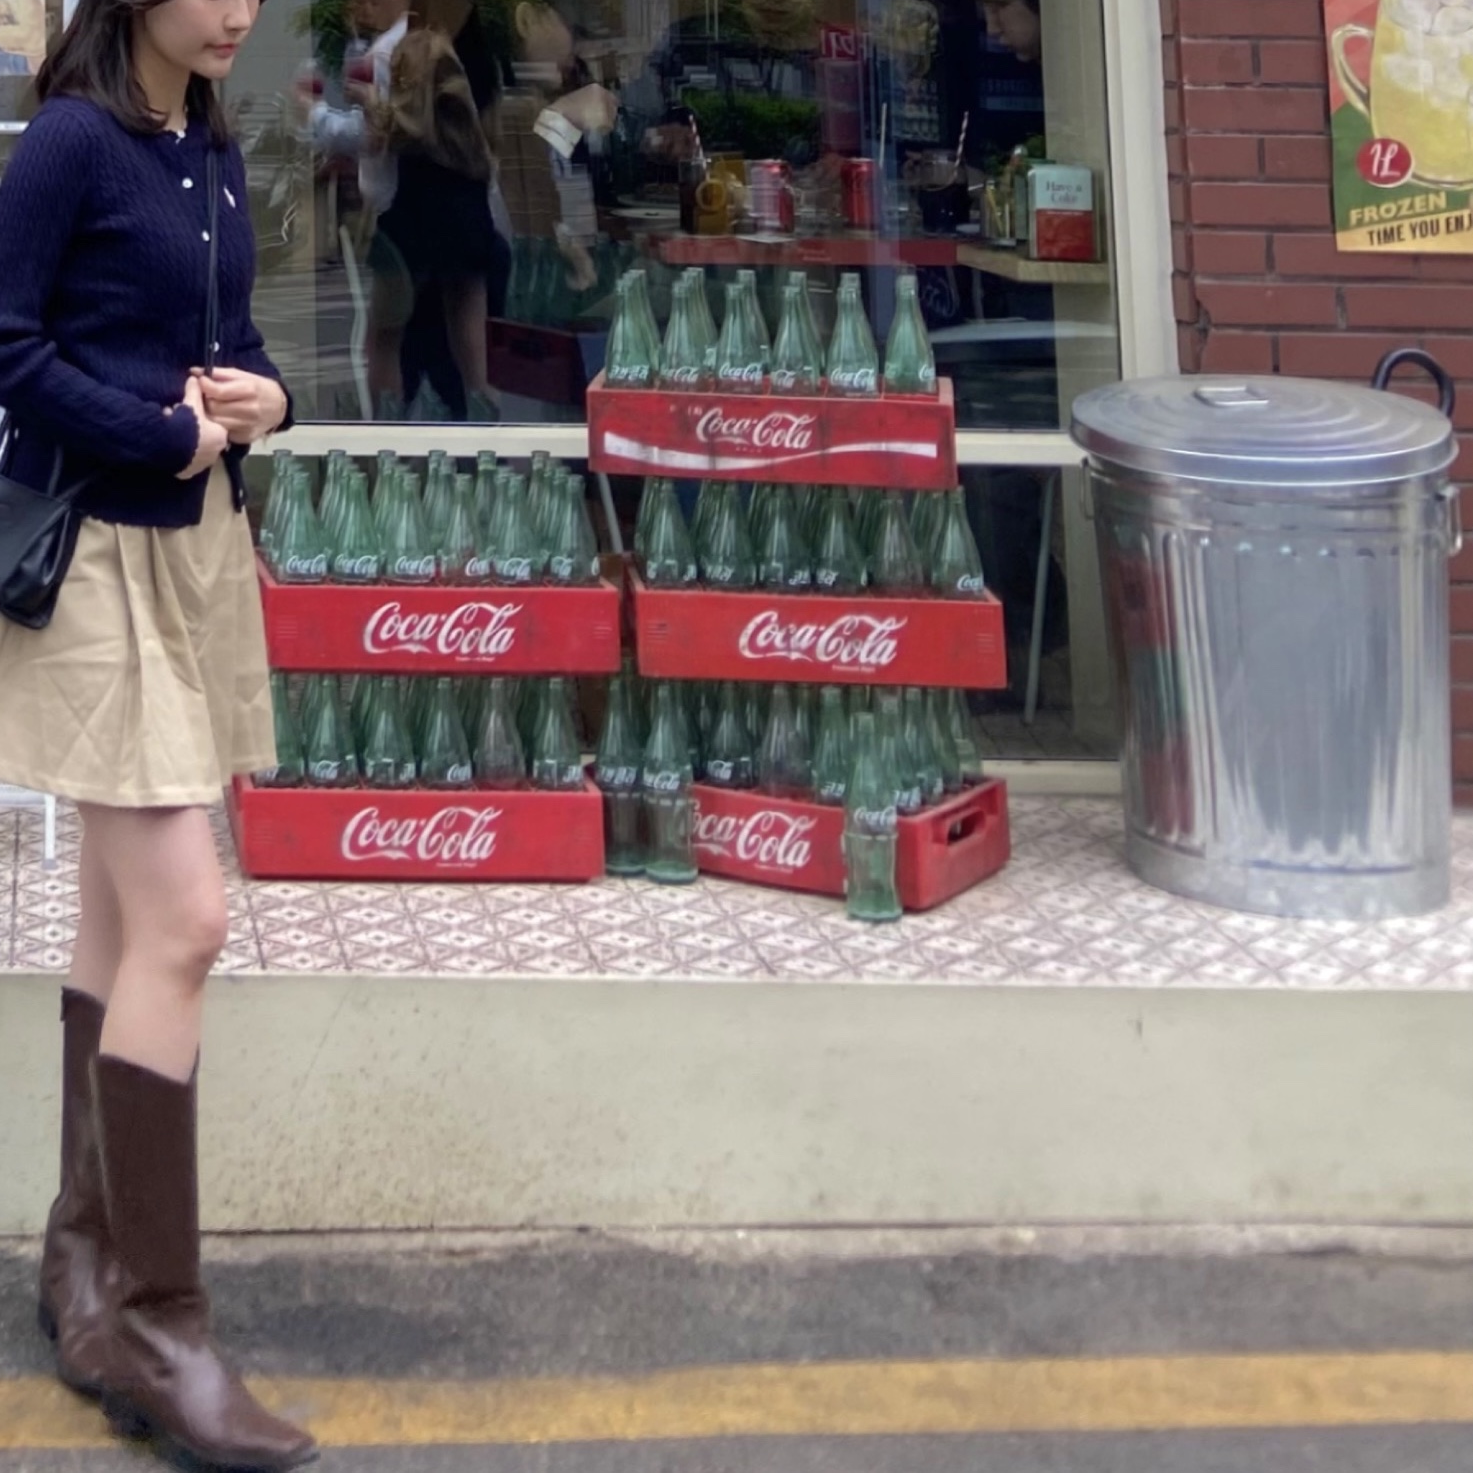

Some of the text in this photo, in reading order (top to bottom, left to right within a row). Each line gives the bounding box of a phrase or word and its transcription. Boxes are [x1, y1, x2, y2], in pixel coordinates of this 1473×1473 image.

[1349, 191, 1446, 226] FROZEN
[1367, 224, 1405, 247] TIME
[1409, 218, 1440, 240] YOU
